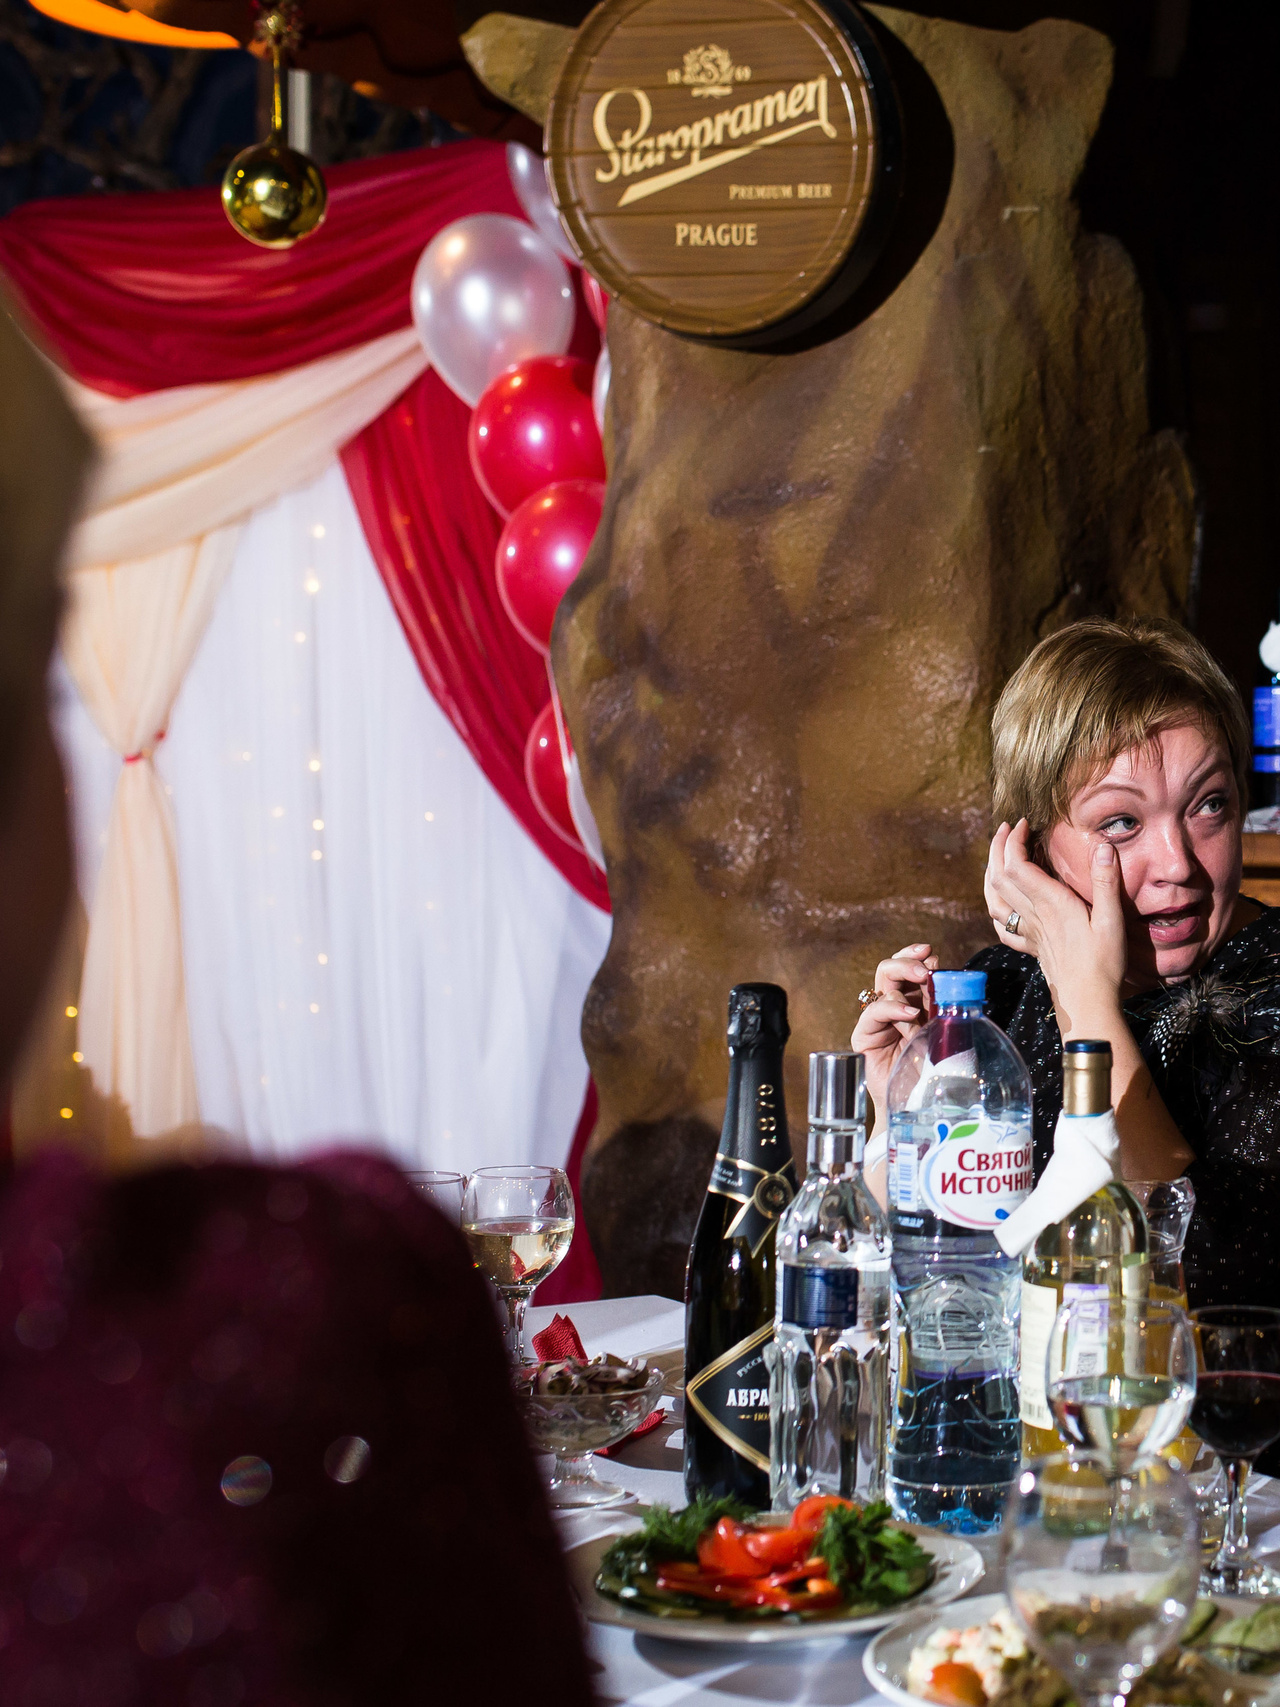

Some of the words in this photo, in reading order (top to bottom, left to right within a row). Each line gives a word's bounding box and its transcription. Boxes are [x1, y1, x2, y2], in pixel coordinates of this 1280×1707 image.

[593, 74, 836, 183] Staropramen
[676, 223, 758, 247] PRAGUE
[941, 1170, 1033, 1194] Источни
[726, 1388, 770, 1407] АБРА
